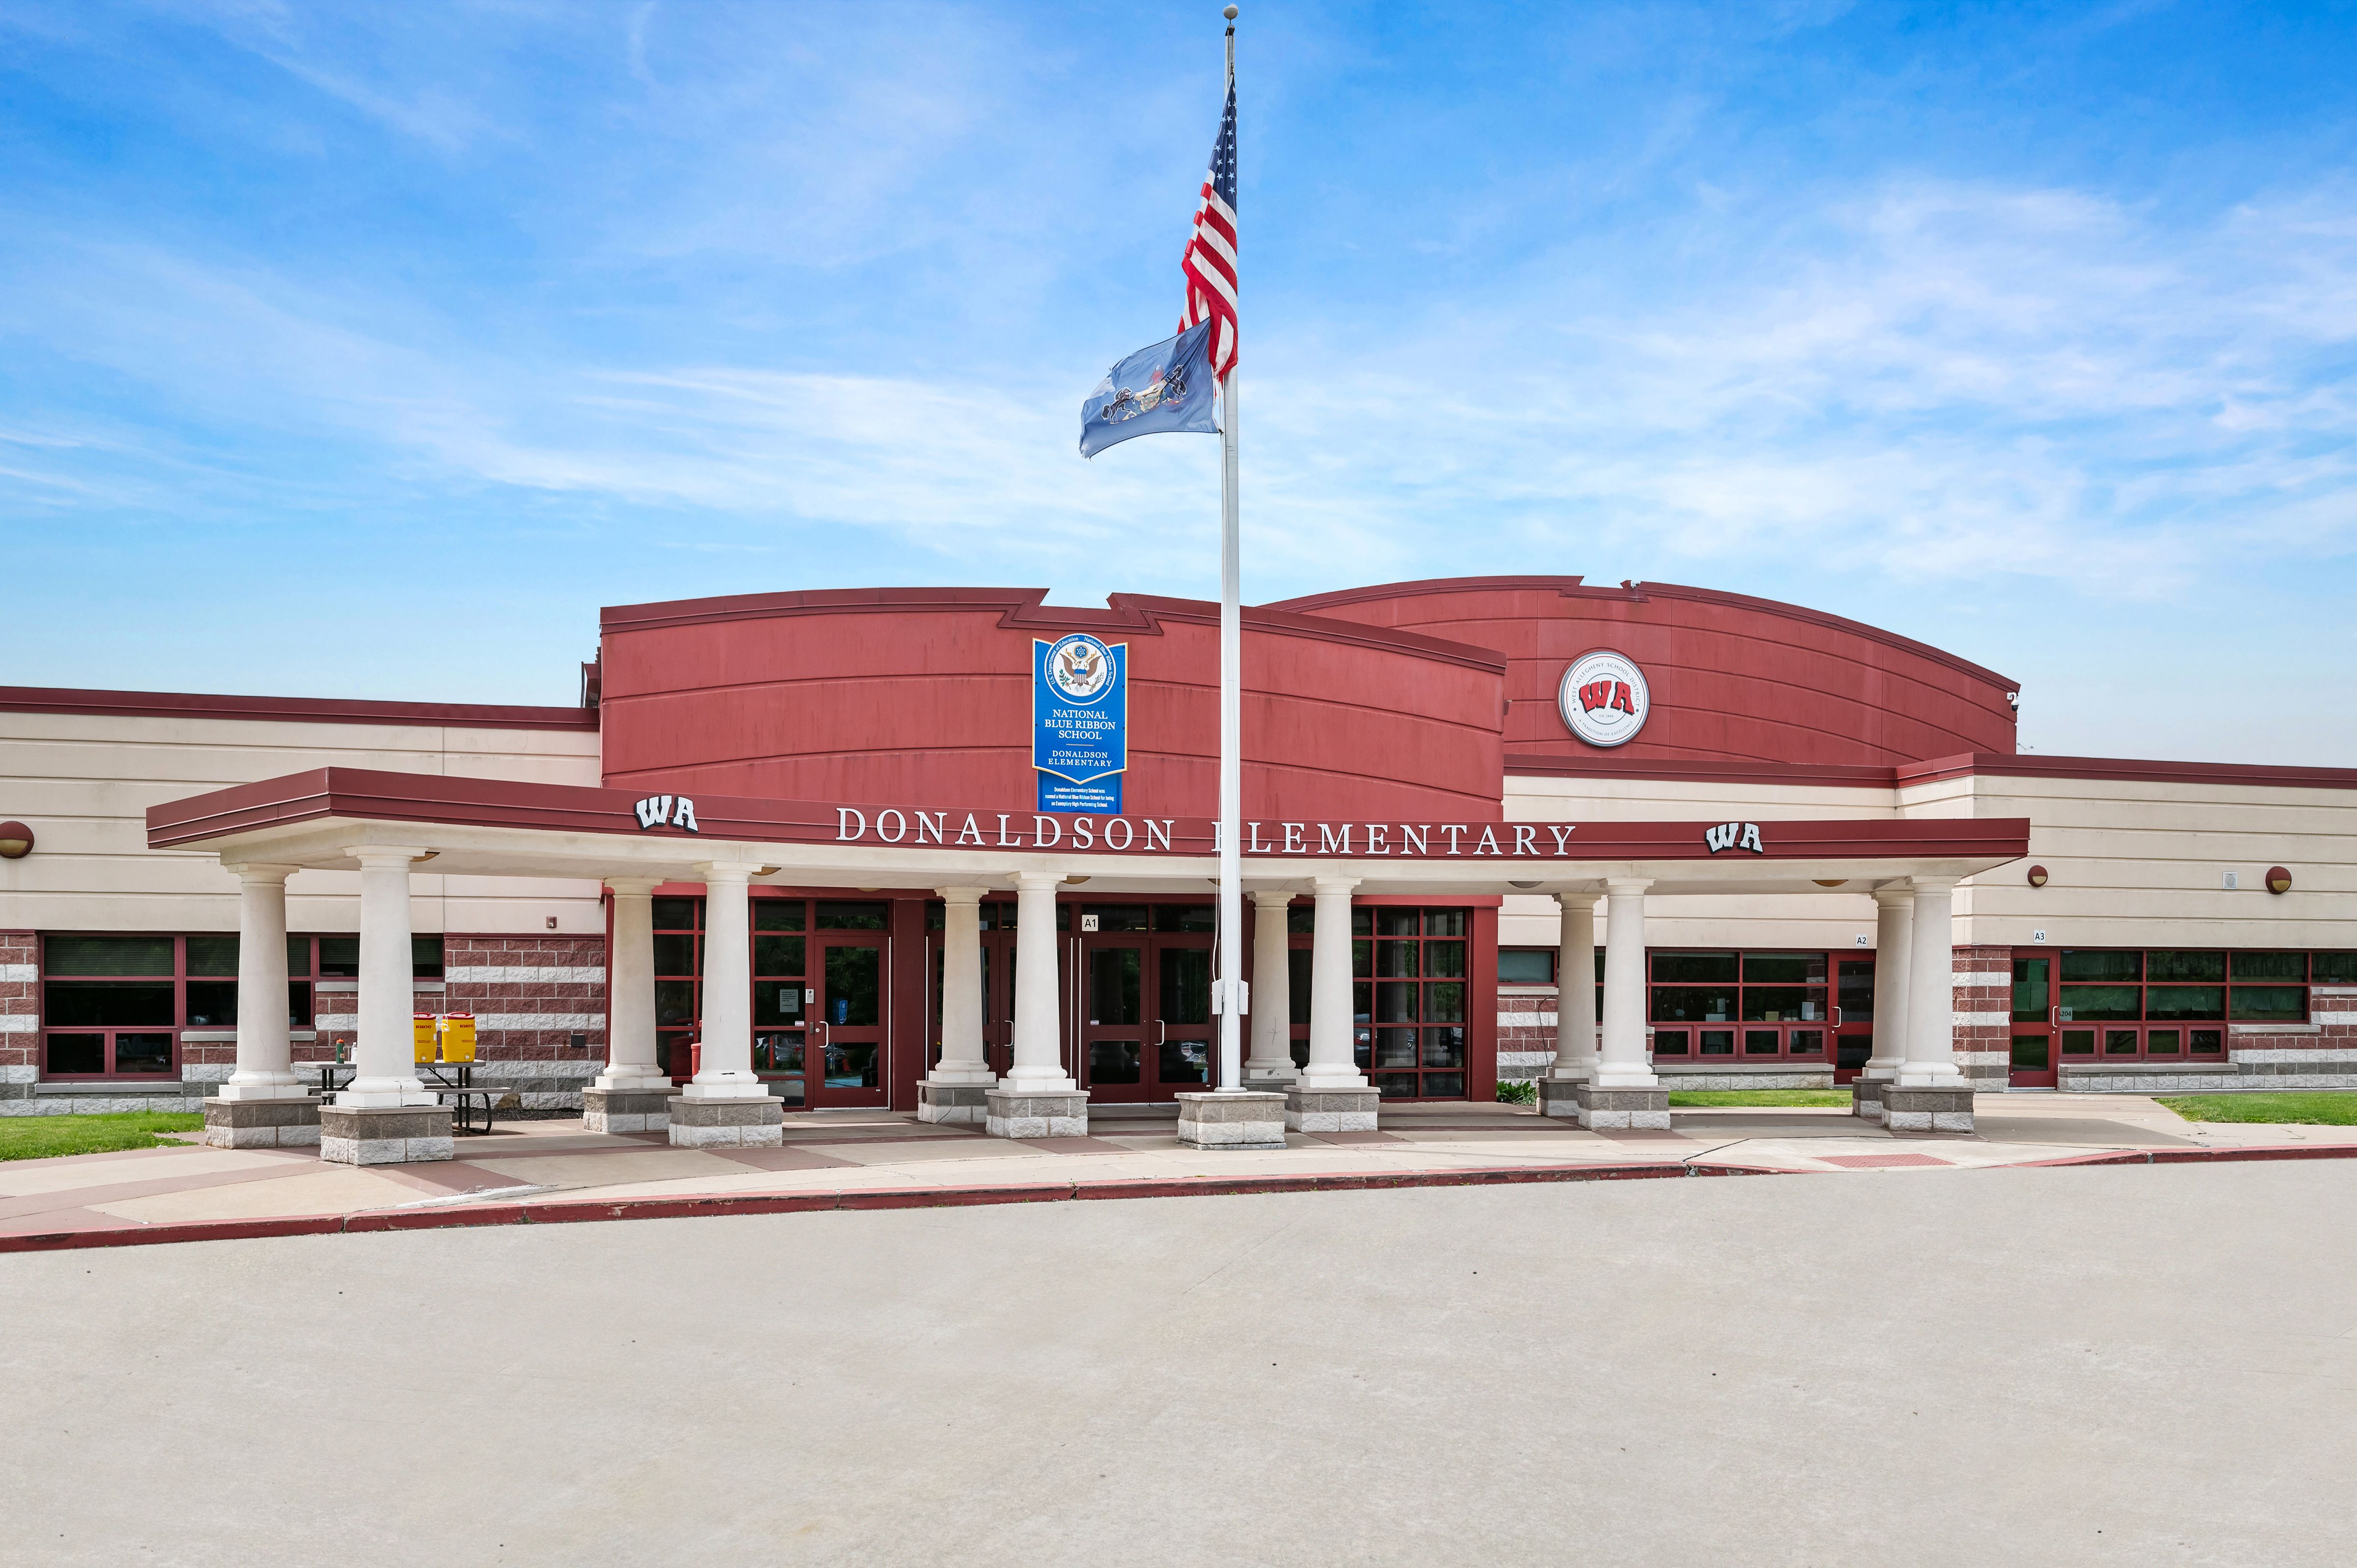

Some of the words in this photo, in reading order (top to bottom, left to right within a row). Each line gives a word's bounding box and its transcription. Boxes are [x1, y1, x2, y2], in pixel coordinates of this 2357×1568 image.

[1084, 637, 1101, 649] National
[1048, 650, 1057, 675] Department
[1059, 637, 1079, 648] Education
[1576, 662, 1604, 684] ALLEGHENY
[1607, 662, 1629, 677] SCHOOL
[1630, 677, 1640, 706] DISTRICT
[1579, 680, 1635, 716] WA
[1052, 709, 1108, 719] NATIONAL
[1044, 719, 1073, 728] BLUE
[1075, 720, 1116, 730] RIBBON
[1582, 722, 1603, 736] TRADITION
[1611, 721, 1633, 736] EXCELLENCE
[1058, 730, 1102, 740] SCHOOL
[1052, 750, 1108, 758] DONALDSON
[1048, 758, 1112, 767] ELEMENTARY
[635, 795, 699, 833] WA
[835, 807, 1175, 851] DONALDSON
[1706, 822, 1763, 854] WA
[1084, 919, 1096, 927] A1
